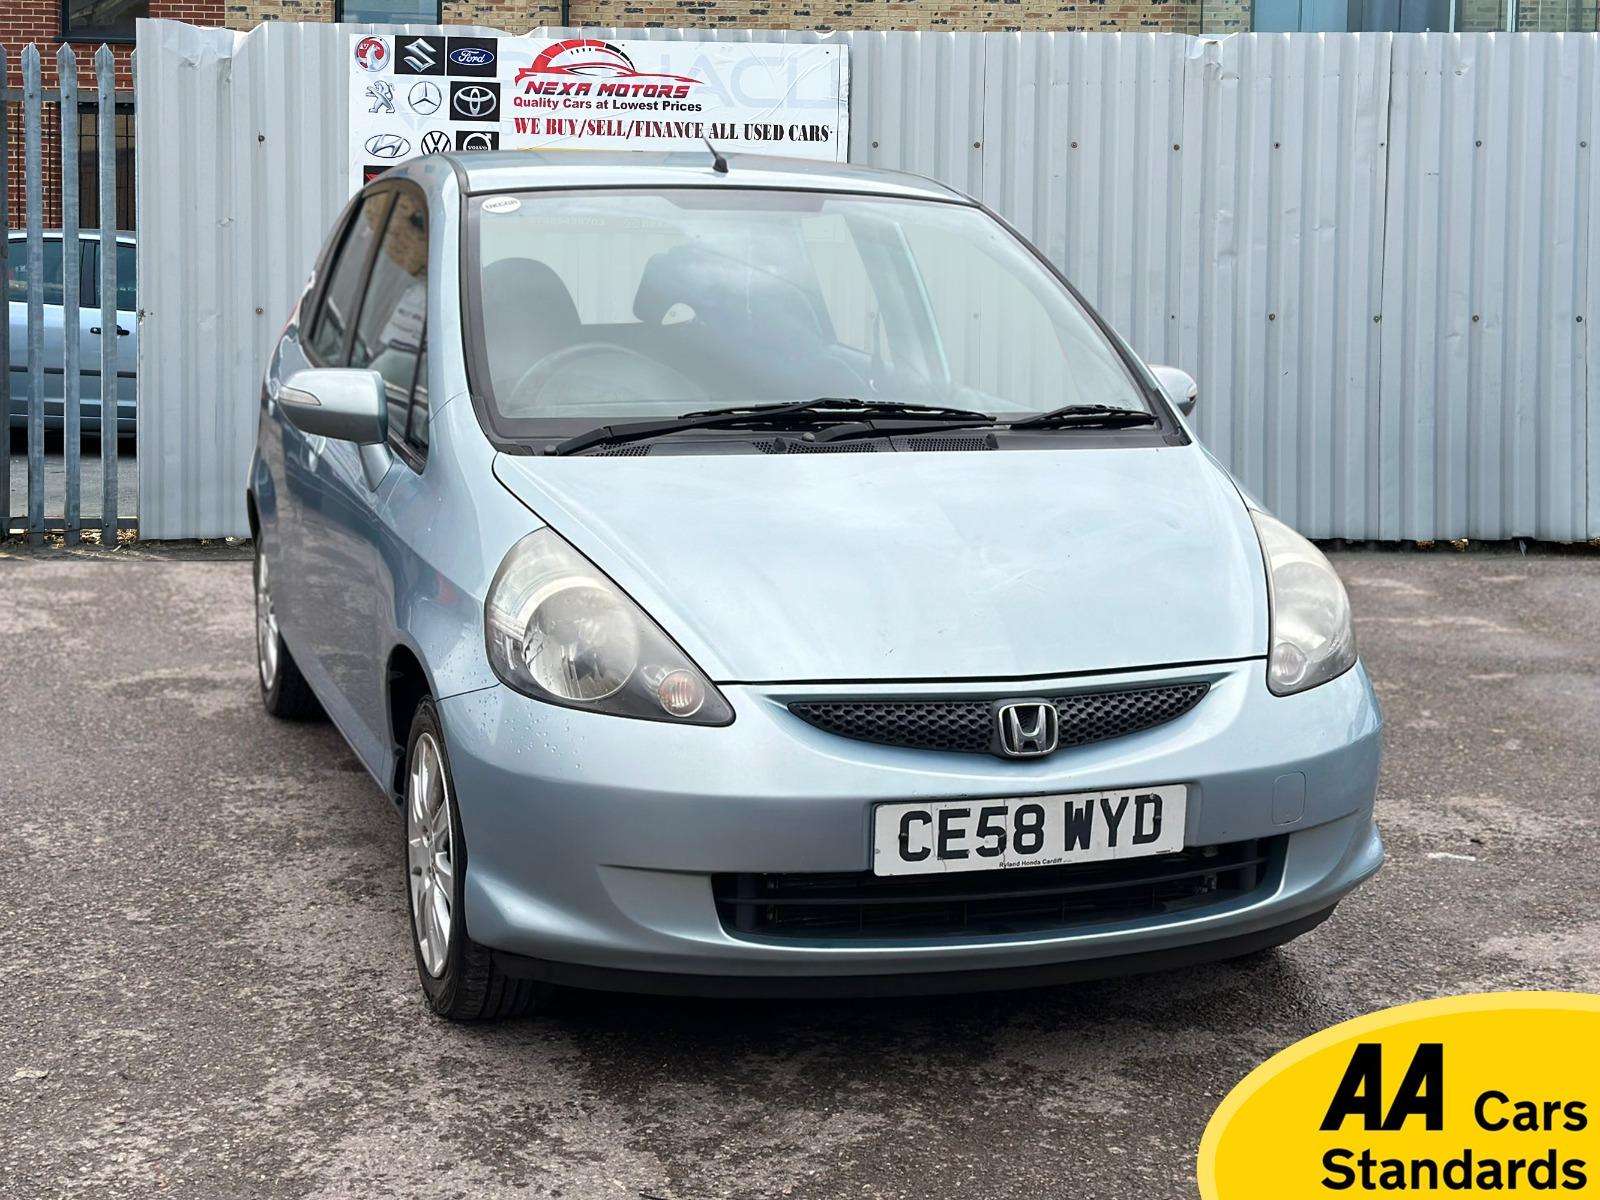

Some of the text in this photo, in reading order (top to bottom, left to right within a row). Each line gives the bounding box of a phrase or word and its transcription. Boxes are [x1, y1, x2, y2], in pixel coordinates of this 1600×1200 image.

[457, 50, 486, 63] Ford
[524, 81, 691, 99] NEXA MOTORS
[513, 97, 702, 112] Quality Cars at Lowest Prices
[514, 117, 830, 142] WE BUY/SELL/FINANCE ALL USED CARS
[898, 793, 1163, 862] CE58 WYD
[999, 861, 1021, 869] Ryland
